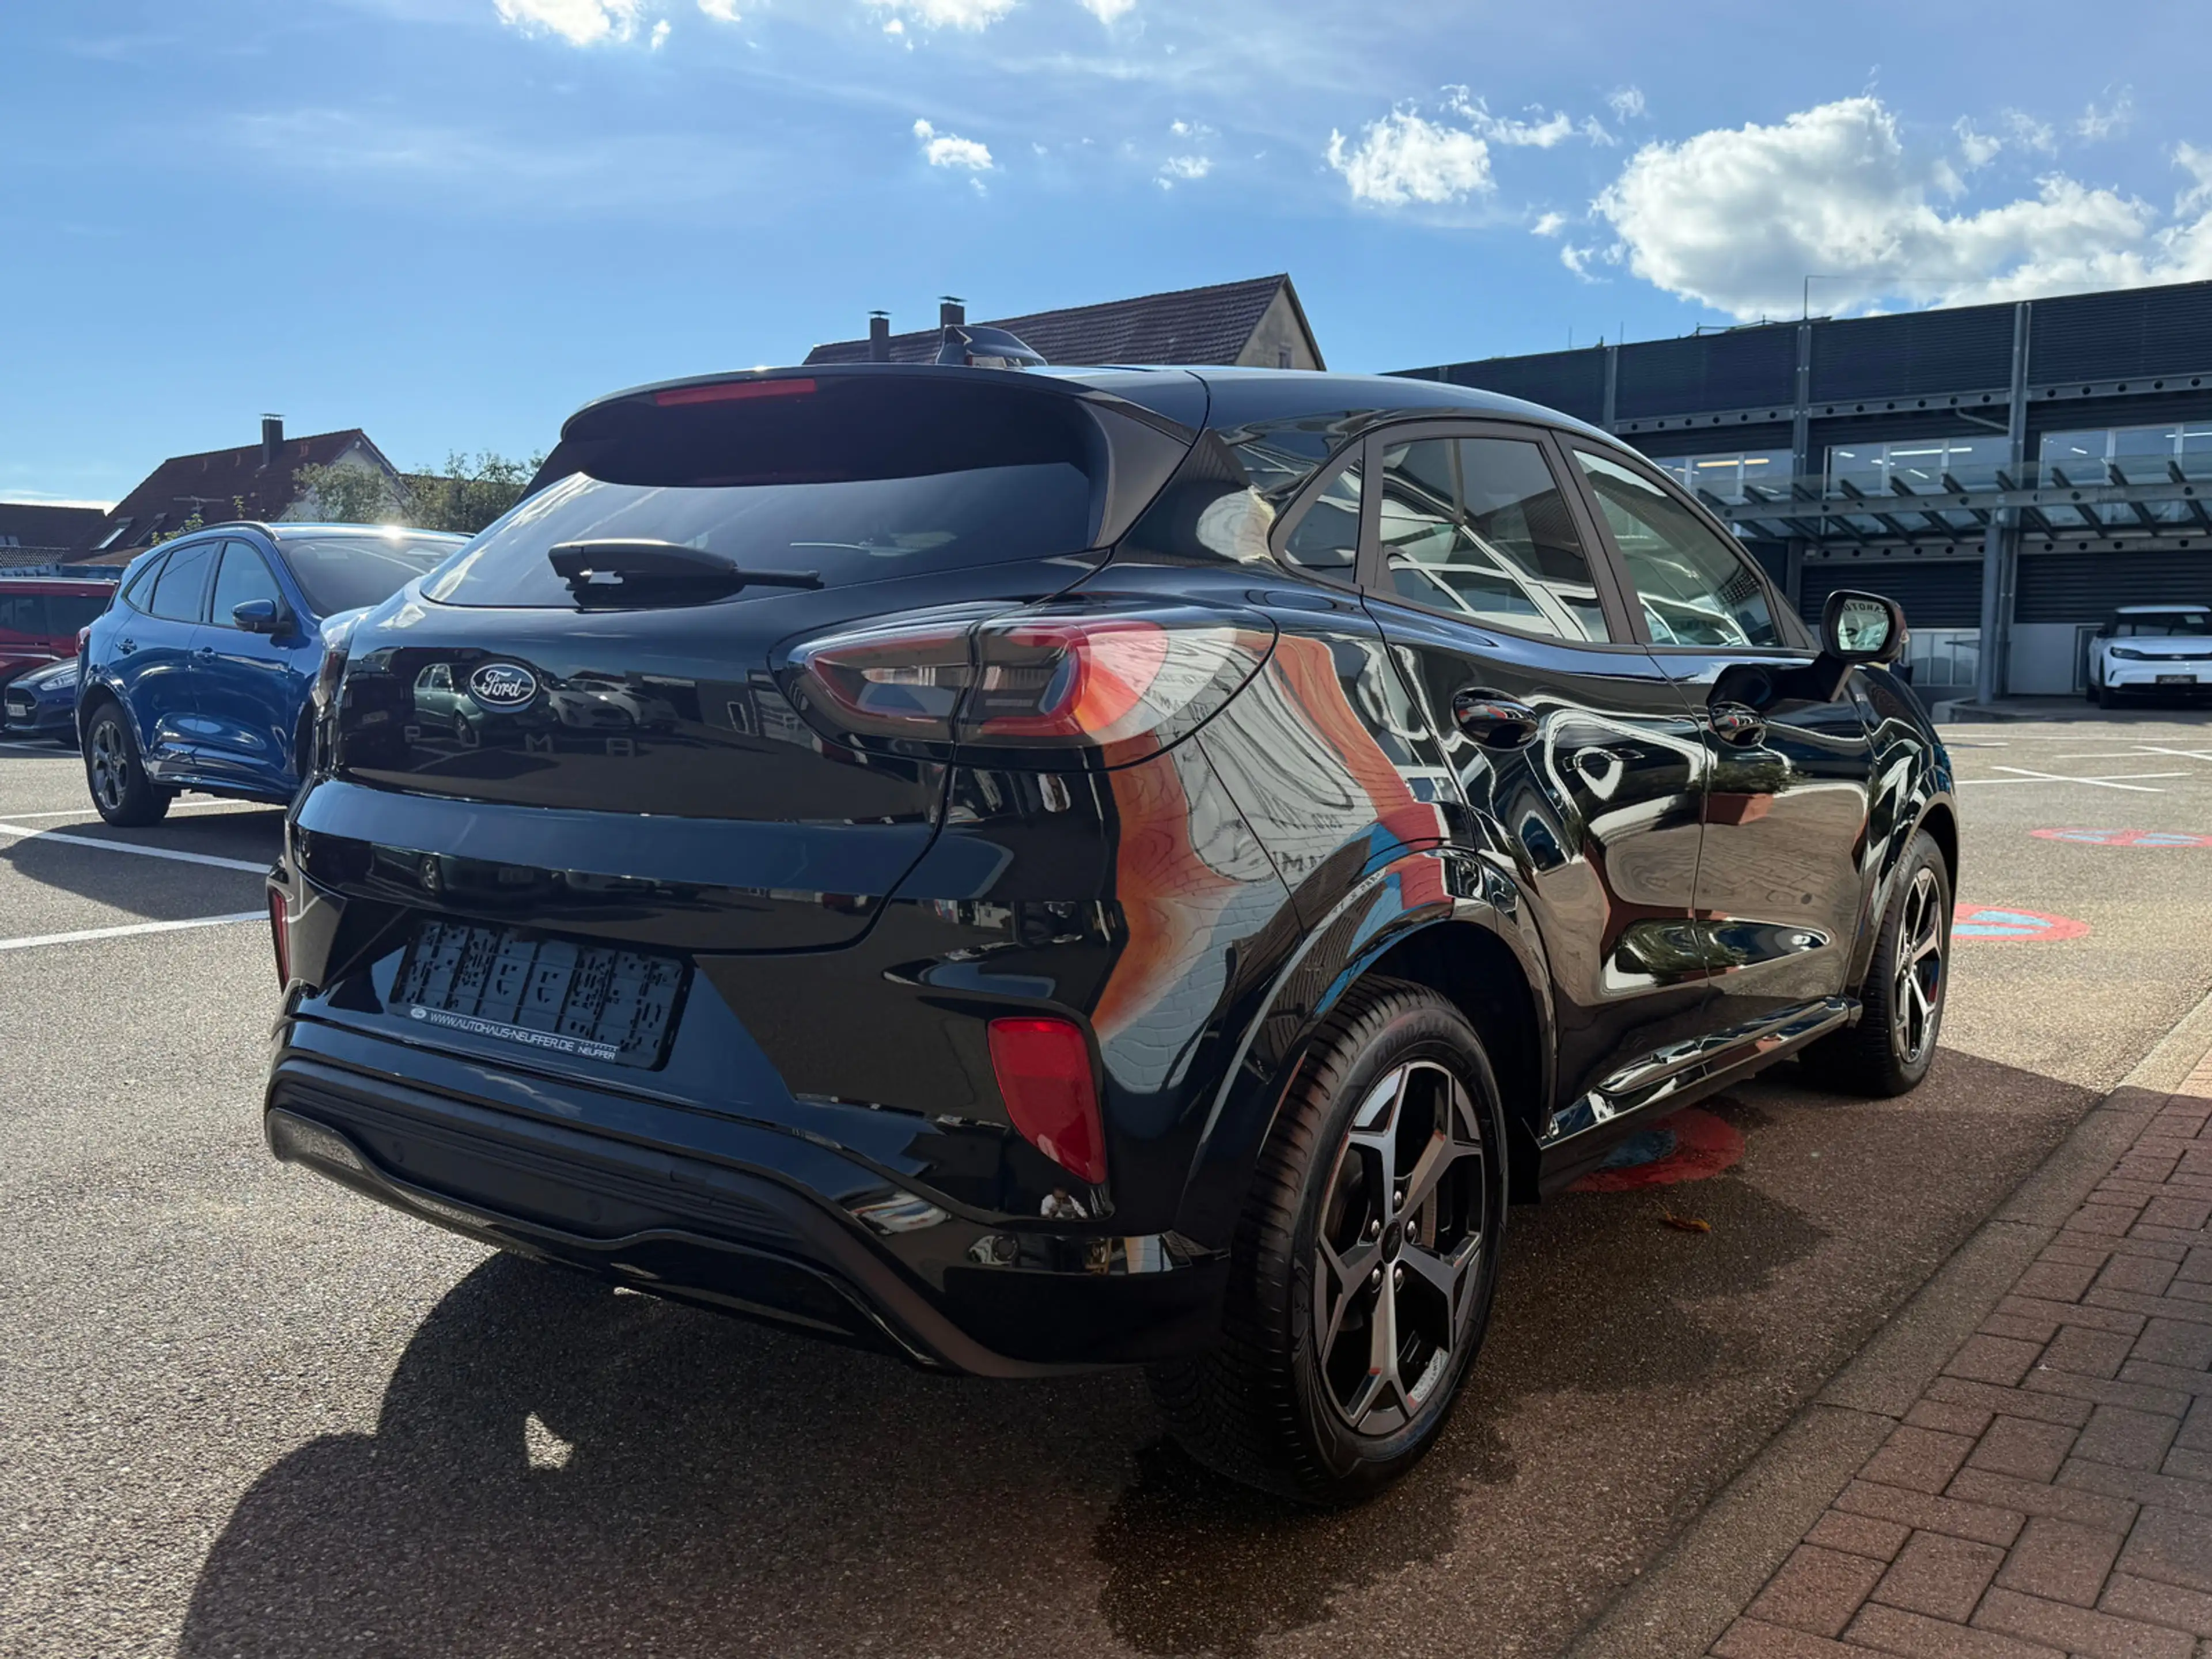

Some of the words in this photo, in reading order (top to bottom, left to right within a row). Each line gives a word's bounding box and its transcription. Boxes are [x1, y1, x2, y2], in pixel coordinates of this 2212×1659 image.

[482, 669, 522, 698] Ford
[404, 726, 635, 758] PUMA
[430, 1012, 575, 1052] WWW.AUTOHAUS-NEUFFER.DE
[578, 1046, 616, 1060] NEUFFER
